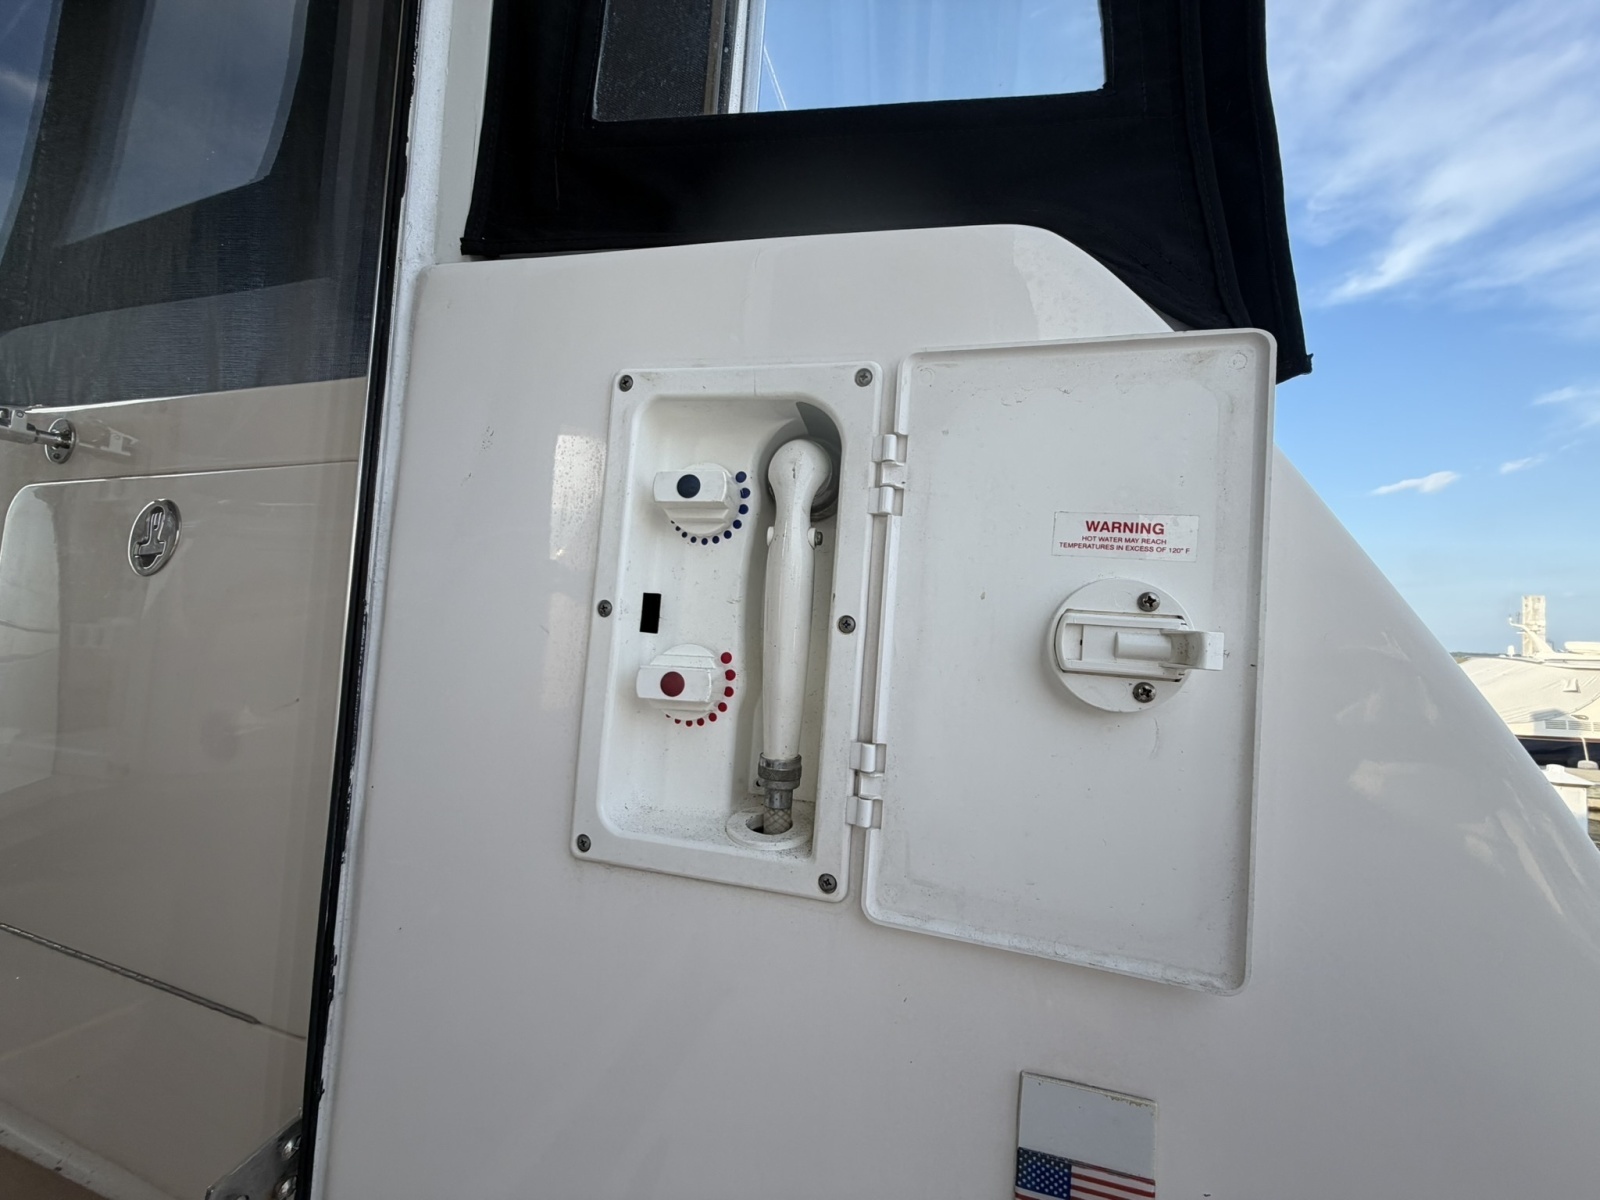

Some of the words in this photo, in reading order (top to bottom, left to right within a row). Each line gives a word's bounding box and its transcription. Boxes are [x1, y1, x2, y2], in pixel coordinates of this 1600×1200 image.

[1085, 520, 1165, 535] WARNING
[1059, 542, 1115, 551] TEMPERATURES
[1125, 545, 1154, 553] EXCESS
